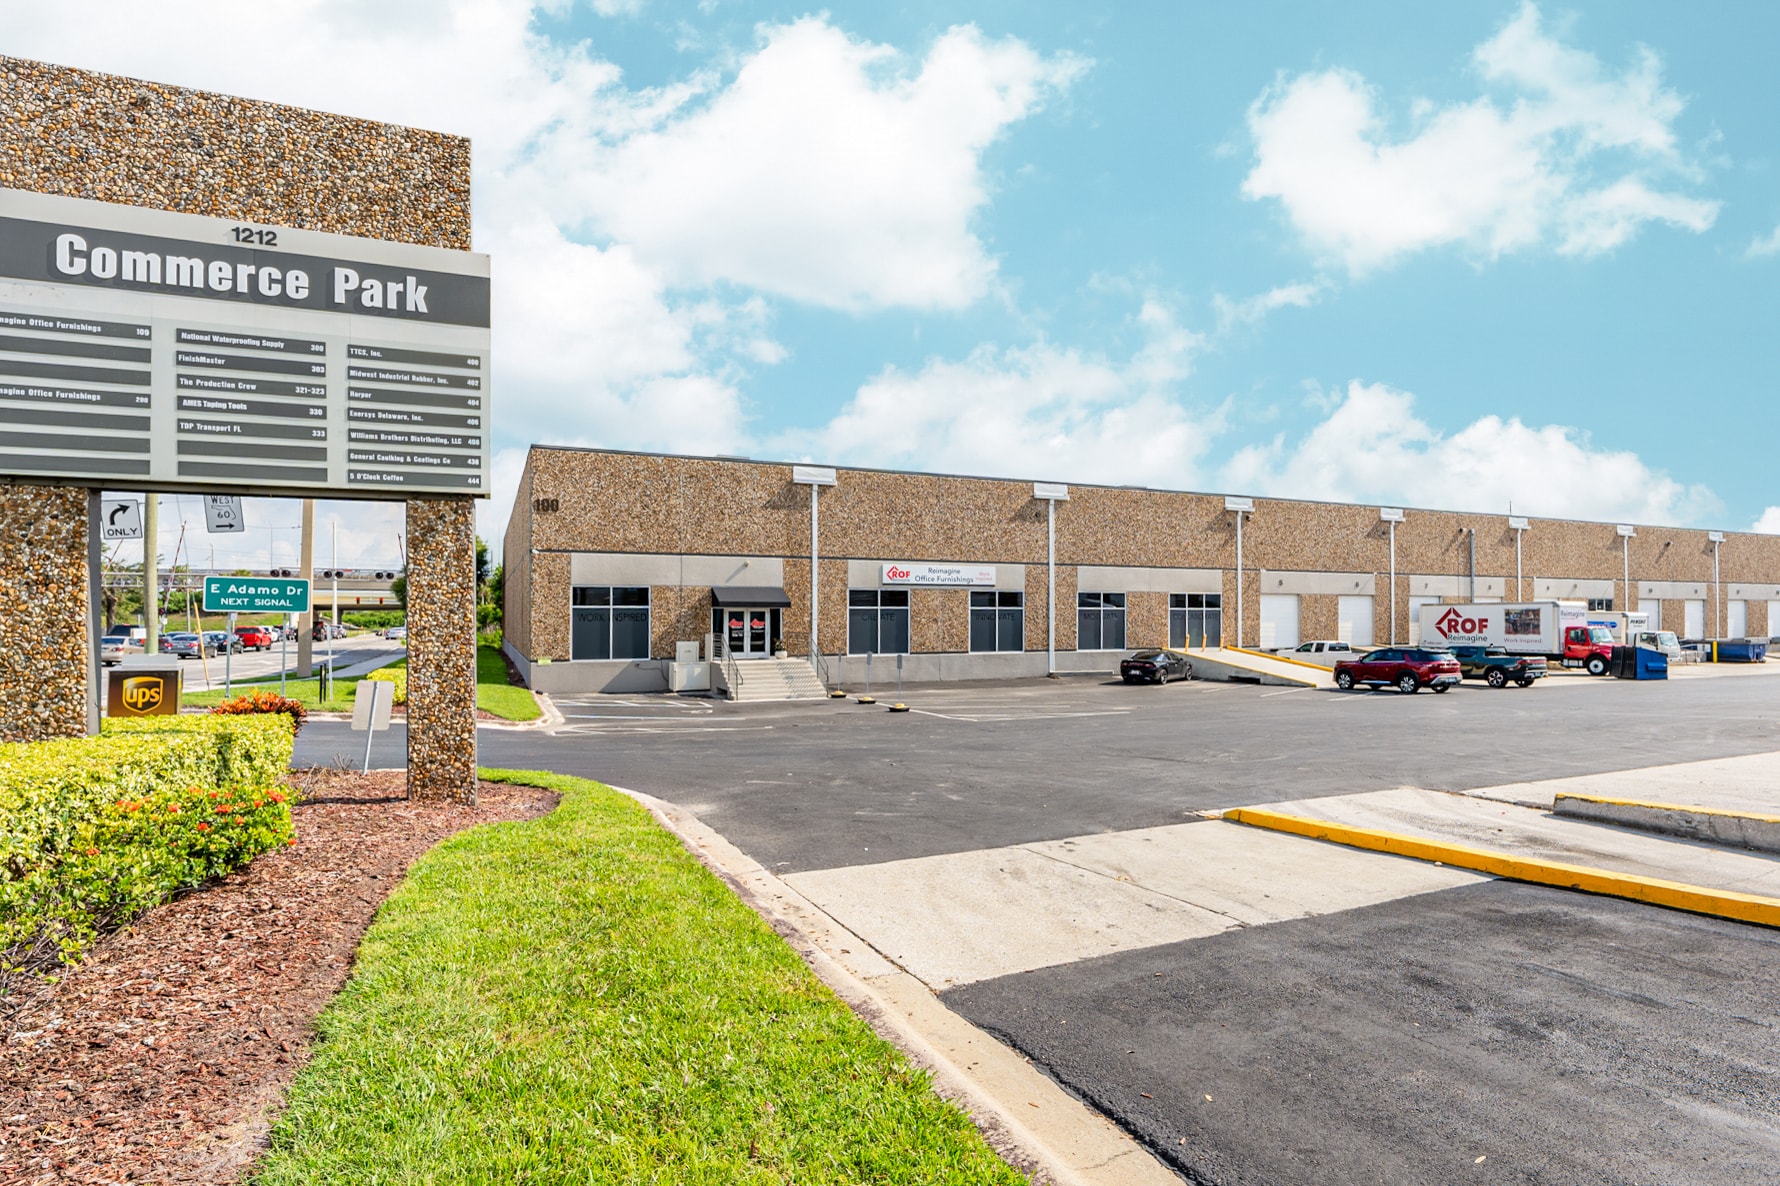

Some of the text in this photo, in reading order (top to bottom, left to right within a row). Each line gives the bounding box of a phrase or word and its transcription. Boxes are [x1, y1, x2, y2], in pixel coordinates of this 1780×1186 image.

[231, 226, 278, 247] 1212
[55, 232, 430, 314] Commerce Park
[29, 318, 54, 328] Office
[56, 321, 102, 333] Furnishings
[181, 331, 324, 353] National Waterproofing Supply 300
[178, 354, 325, 374] FinishMaster 303
[349, 369, 377, 379] Midwest
[179, 377, 325, 396] The Production Crew 321-323
[28, 389, 53, 398] Office
[55, 390, 101, 401] Furnishings
[182, 399, 323, 416] AMES Taping Tools 330
[180, 421, 325, 438] TDP Transport FL 333
[350, 432, 378, 440] Williams
[380, 433, 409, 442] Brothers
[349, 452, 375, 461] General
[376, 454, 404, 463] Caulking
[382, 474, 404, 482] Coffee
[467, 477, 480, 485] 444
[211, 495, 235, 505] WEST
[217, 510, 231, 519] 60
[107, 527, 138, 537] ONLY
[891, 570, 911, 579] ROF
[928, 567, 961, 577] Reimagine
[914, 574, 936, 583] Office
[936, 575, 974, 585] Furnishings
[210, 583, 303, 596] E Adamo Dr
[220, 597, 293, 607] NEXT SIGNAL
[578, 612, 605, 622] WORK
[1561, 609, 1585, 618] Reimagine
[1447, 618, 1489, 634] ROF
[1447, 633, 1488, 643] Reimagine
[125, 686, 160, 708] ups
